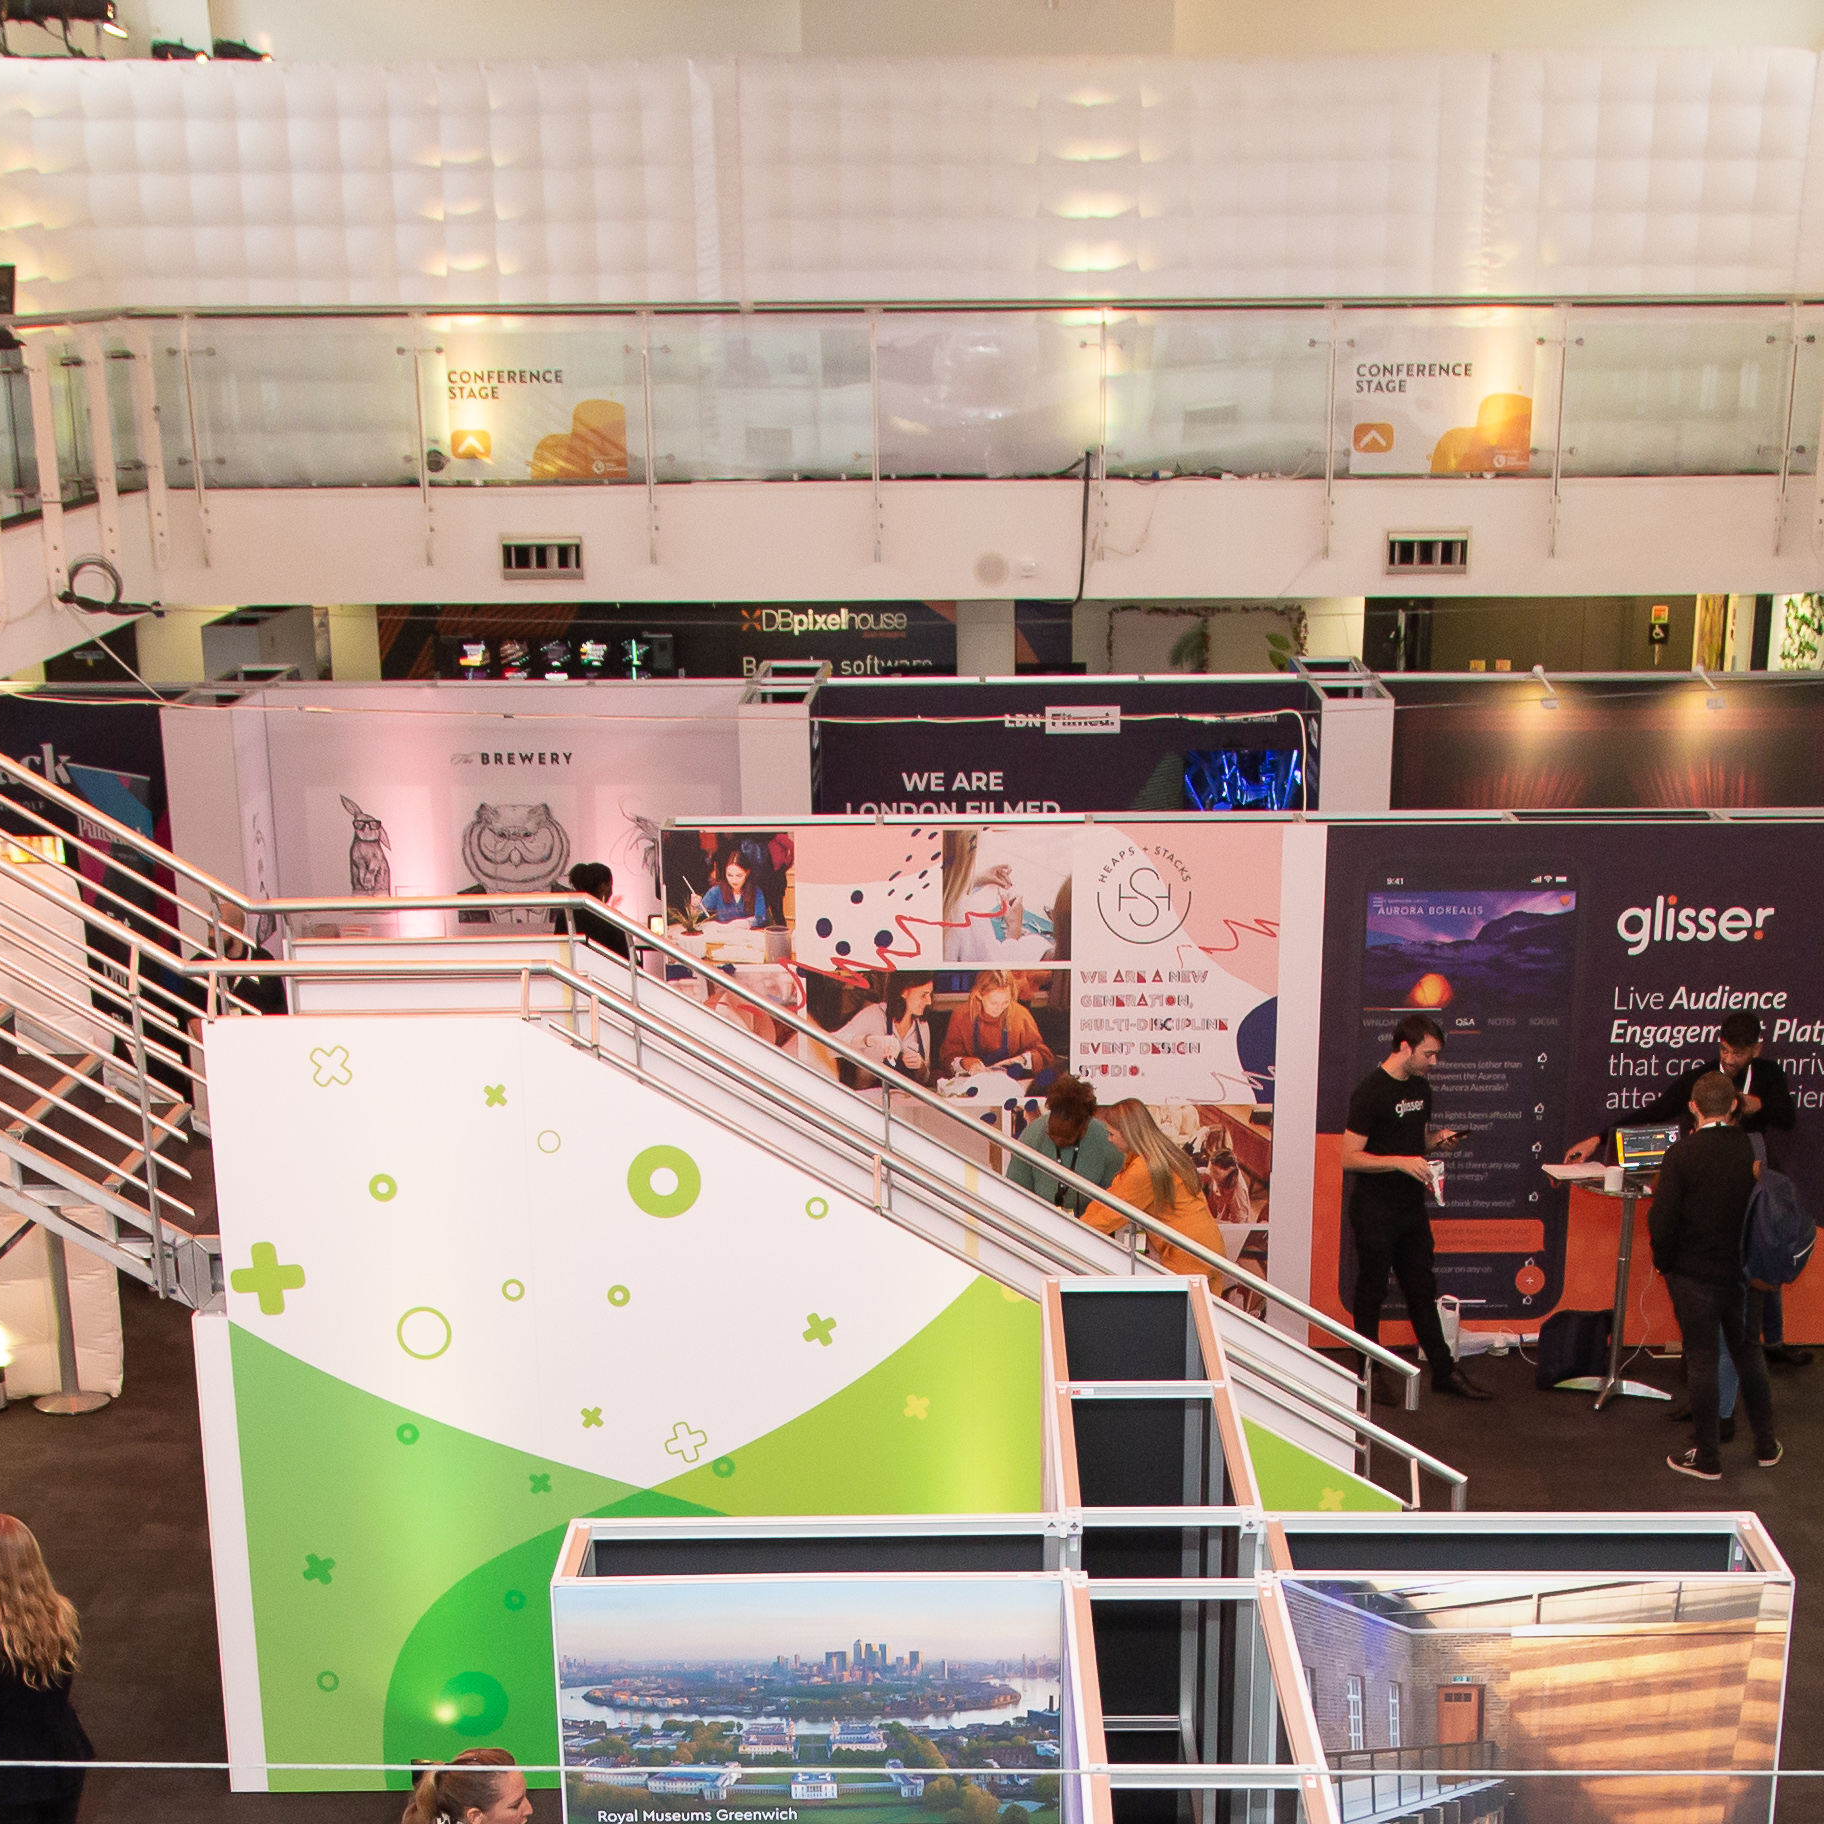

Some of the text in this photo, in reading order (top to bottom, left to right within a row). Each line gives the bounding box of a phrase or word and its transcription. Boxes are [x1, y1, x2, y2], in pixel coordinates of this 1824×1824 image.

[447, 368, 564, 384] CONFERENCE
[1356, 362, 1473, 378] CONFERENCE
[448, 385, 500, 400] STAGE
[1356, 379, 1407, 393] STAGE
[761, 608, 909, 636] DBpixelhouse
[480, 751, 573, 766] BREWERY
[902, 771, 1004, 792] WE ARE
[1097, 845, 1192, 884] HEAPS STACKS
[1377, 905, 1484, 916] AURORA BOREALIS
[1616, 894, 1776, 957] glisser
[1079, 970, 1108, 984] WE
[1168, 969, 1209, 984] NEW
[1613, 984, 1788, 1011] Live Audience
[1454, 1017, 1476, 1027] Q&A
[1487, 1017, 1516, 1027] NOTES
[1609, 1018, 1767, 1049] Engagemt
[1079, 1041, 1201, 1056] EVENT DESIGN
[1608, 1052, 1660, 1077] that
[1477, 1071, 1507, 1081] Aurora
[1440, 1082, 1469, 1092] Aurora
[1484, 1109, 1522, 1120] affected
[651, 1805, 713, 1824] Museums
[716, 1803, 799, 1823] Greenwich
